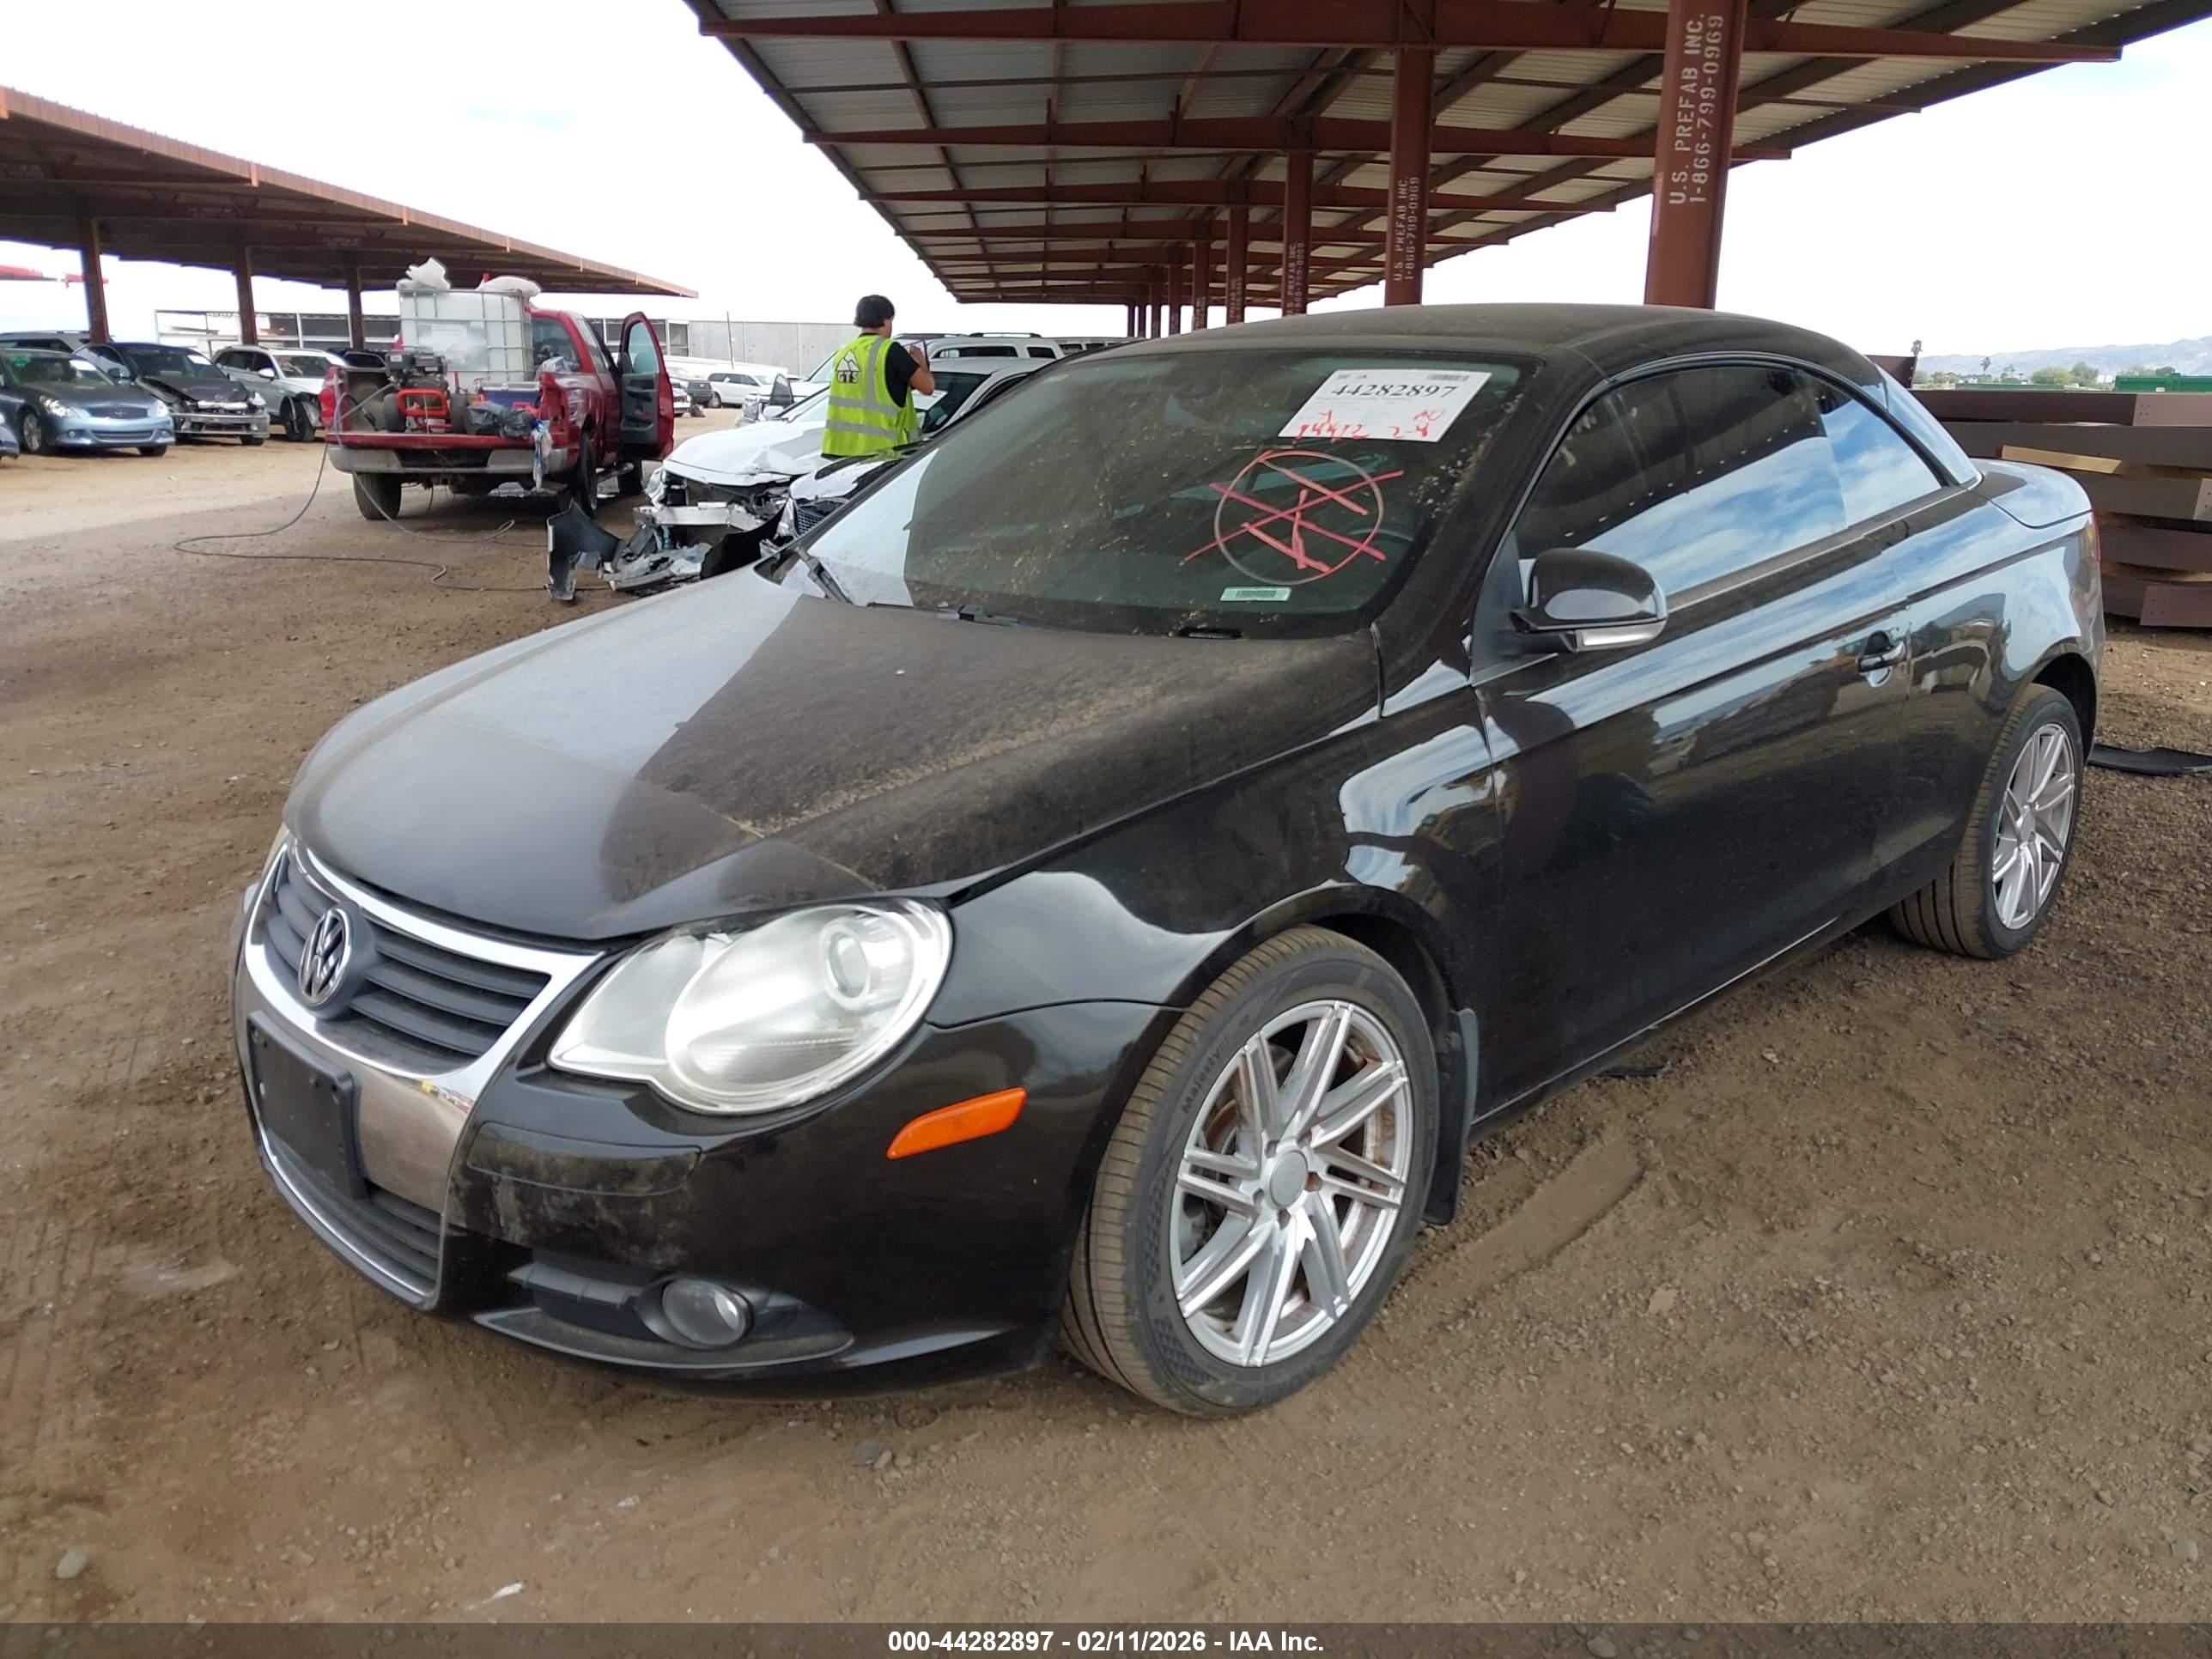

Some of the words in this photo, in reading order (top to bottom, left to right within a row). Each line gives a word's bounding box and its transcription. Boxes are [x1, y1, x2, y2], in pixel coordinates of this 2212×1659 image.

[1684, 13, 1705, 55] INC.
[1674, 67, 1698, 152] PREFAB
[1690, 15, 1725, 204] 1-866-799-0969
[1669, 166, 1689, 204] U.S.
[1395, 205, 1407, 252] PREFAB
[837, 371, 859, 384] GTS
[1331, 384, 1459, 398] 44282897
